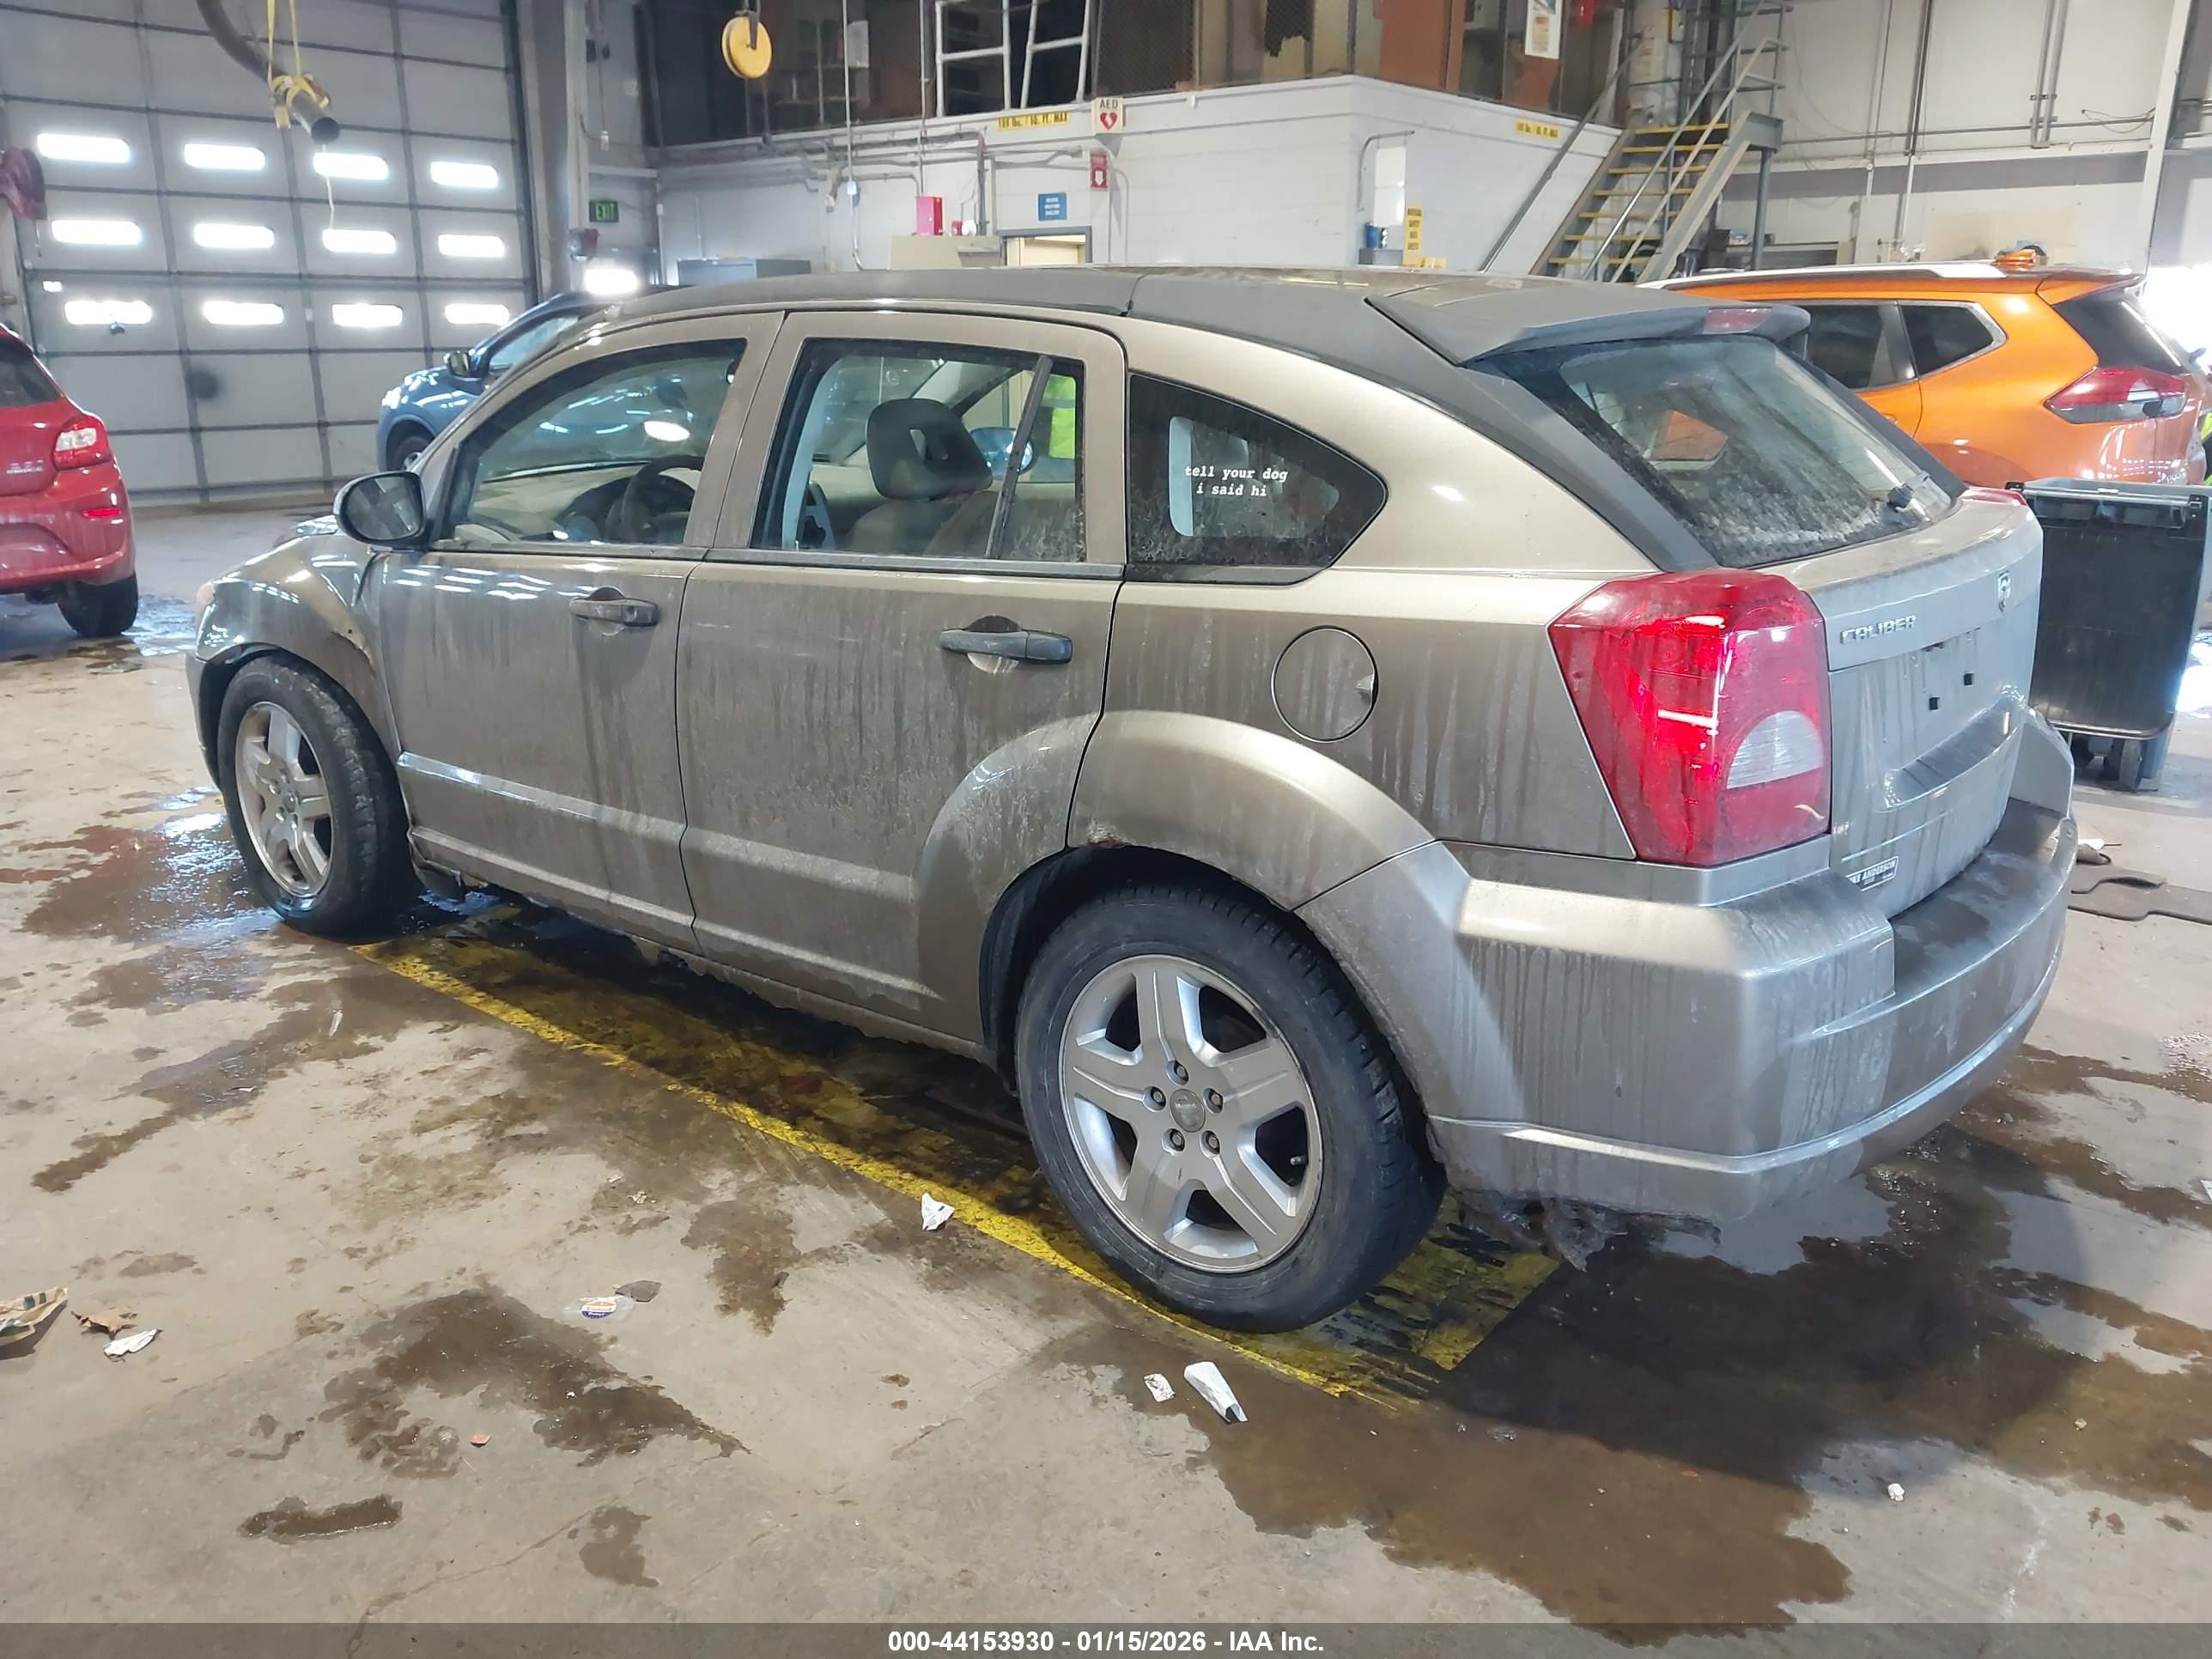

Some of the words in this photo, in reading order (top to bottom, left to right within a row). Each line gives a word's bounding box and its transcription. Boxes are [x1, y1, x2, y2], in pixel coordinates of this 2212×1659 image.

[1099, 99, 1118, 109] AED
[1184, 465, 1215, 477] tell
[1223, 469, 1255, 481] your
[1262, 468, 1289, 483] dog
[1196, 483, 1204, 495] i
[1212, 484, 1244, 495] said
[1250, 485, 1267, 496] hi
[1839, 615, 1917, 644] CALIBER
